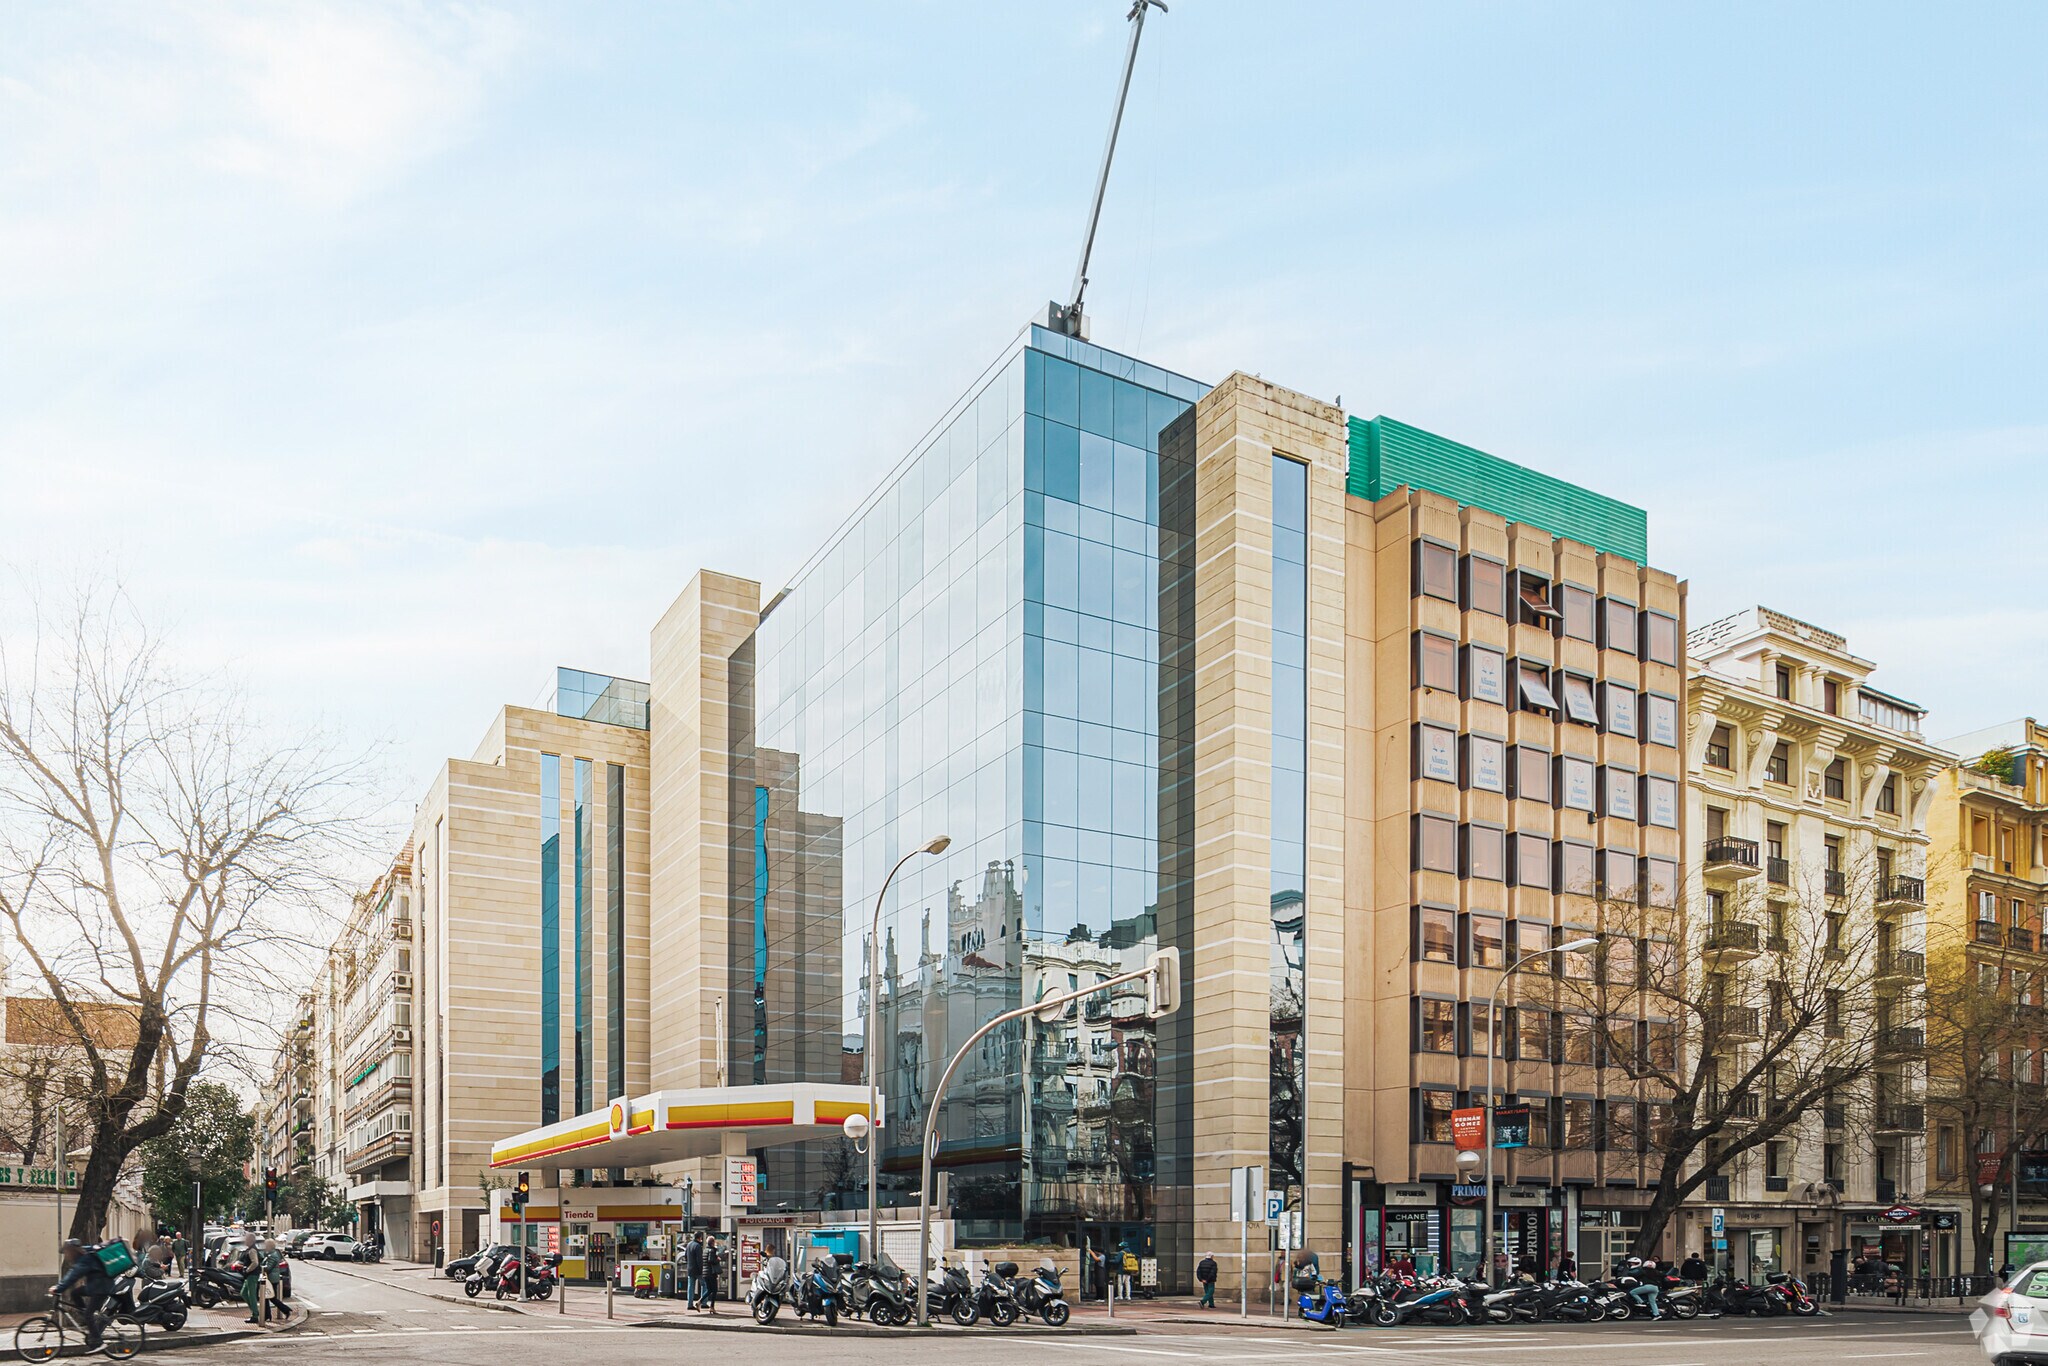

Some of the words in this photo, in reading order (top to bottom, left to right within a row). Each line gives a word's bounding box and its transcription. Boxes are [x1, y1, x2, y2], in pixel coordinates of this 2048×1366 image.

[17, 1168, 24, 1183] Y
[564, 1211, 594, 1219] Tienda
[1270, 1201, 1279, 1217] P
[1714, 1216, 1721, 1230] P
